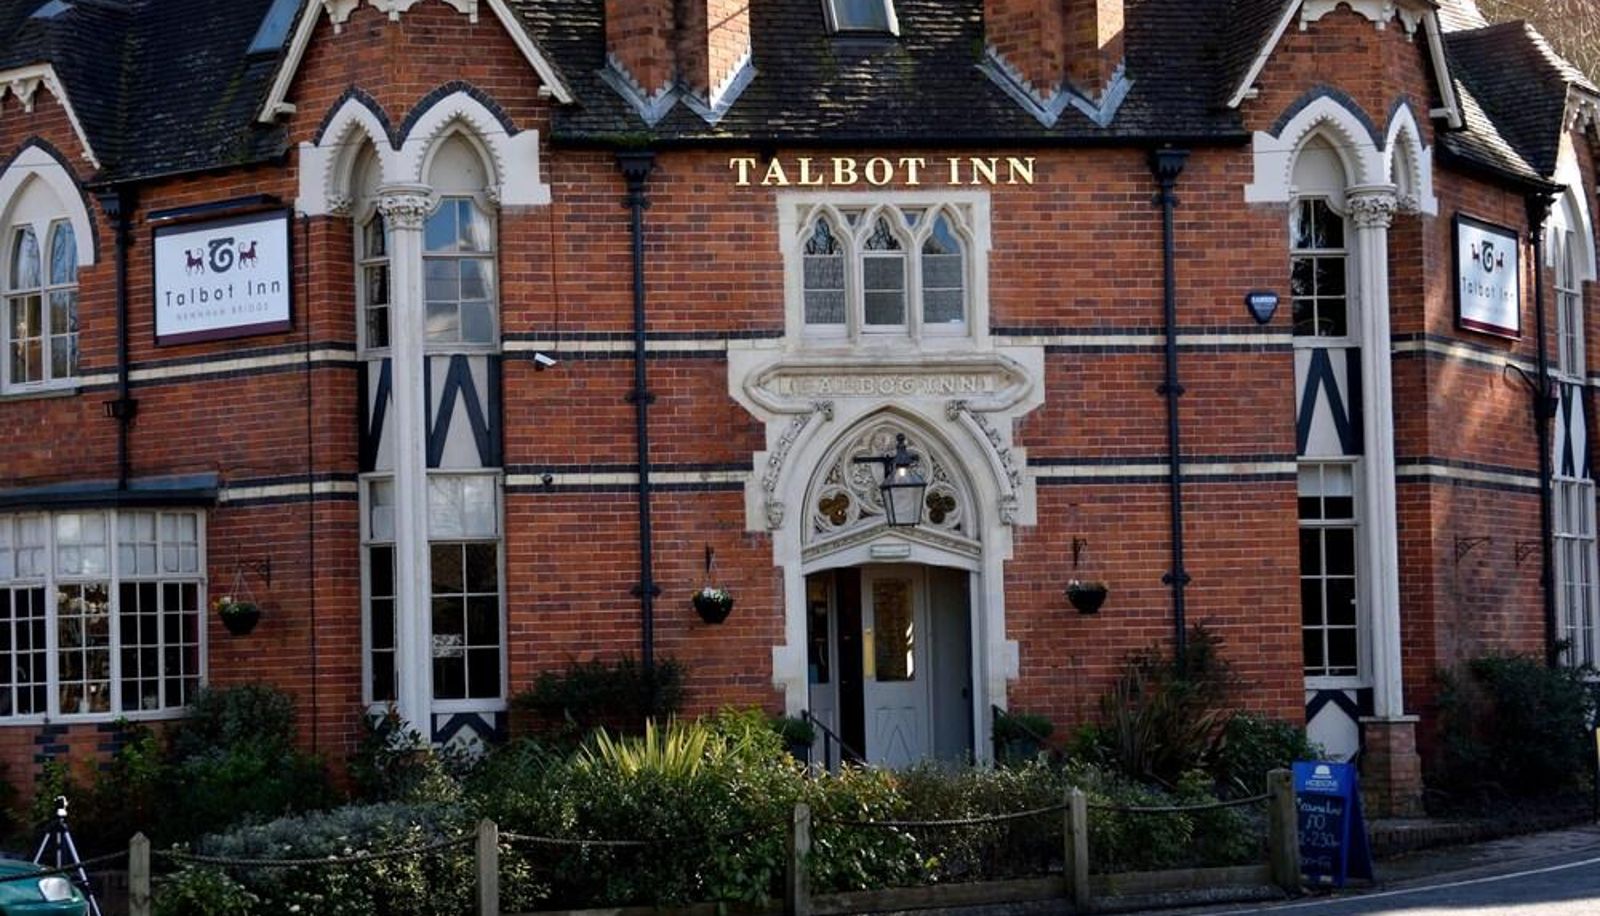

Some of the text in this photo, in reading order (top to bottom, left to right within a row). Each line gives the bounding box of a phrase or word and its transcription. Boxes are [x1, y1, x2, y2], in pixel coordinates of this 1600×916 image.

[729, 157, 1036, 186] TALBOT INN
[166, 280, 280, 307] Talbot Inn
[1462, 276, 1495, 299] Talbot
